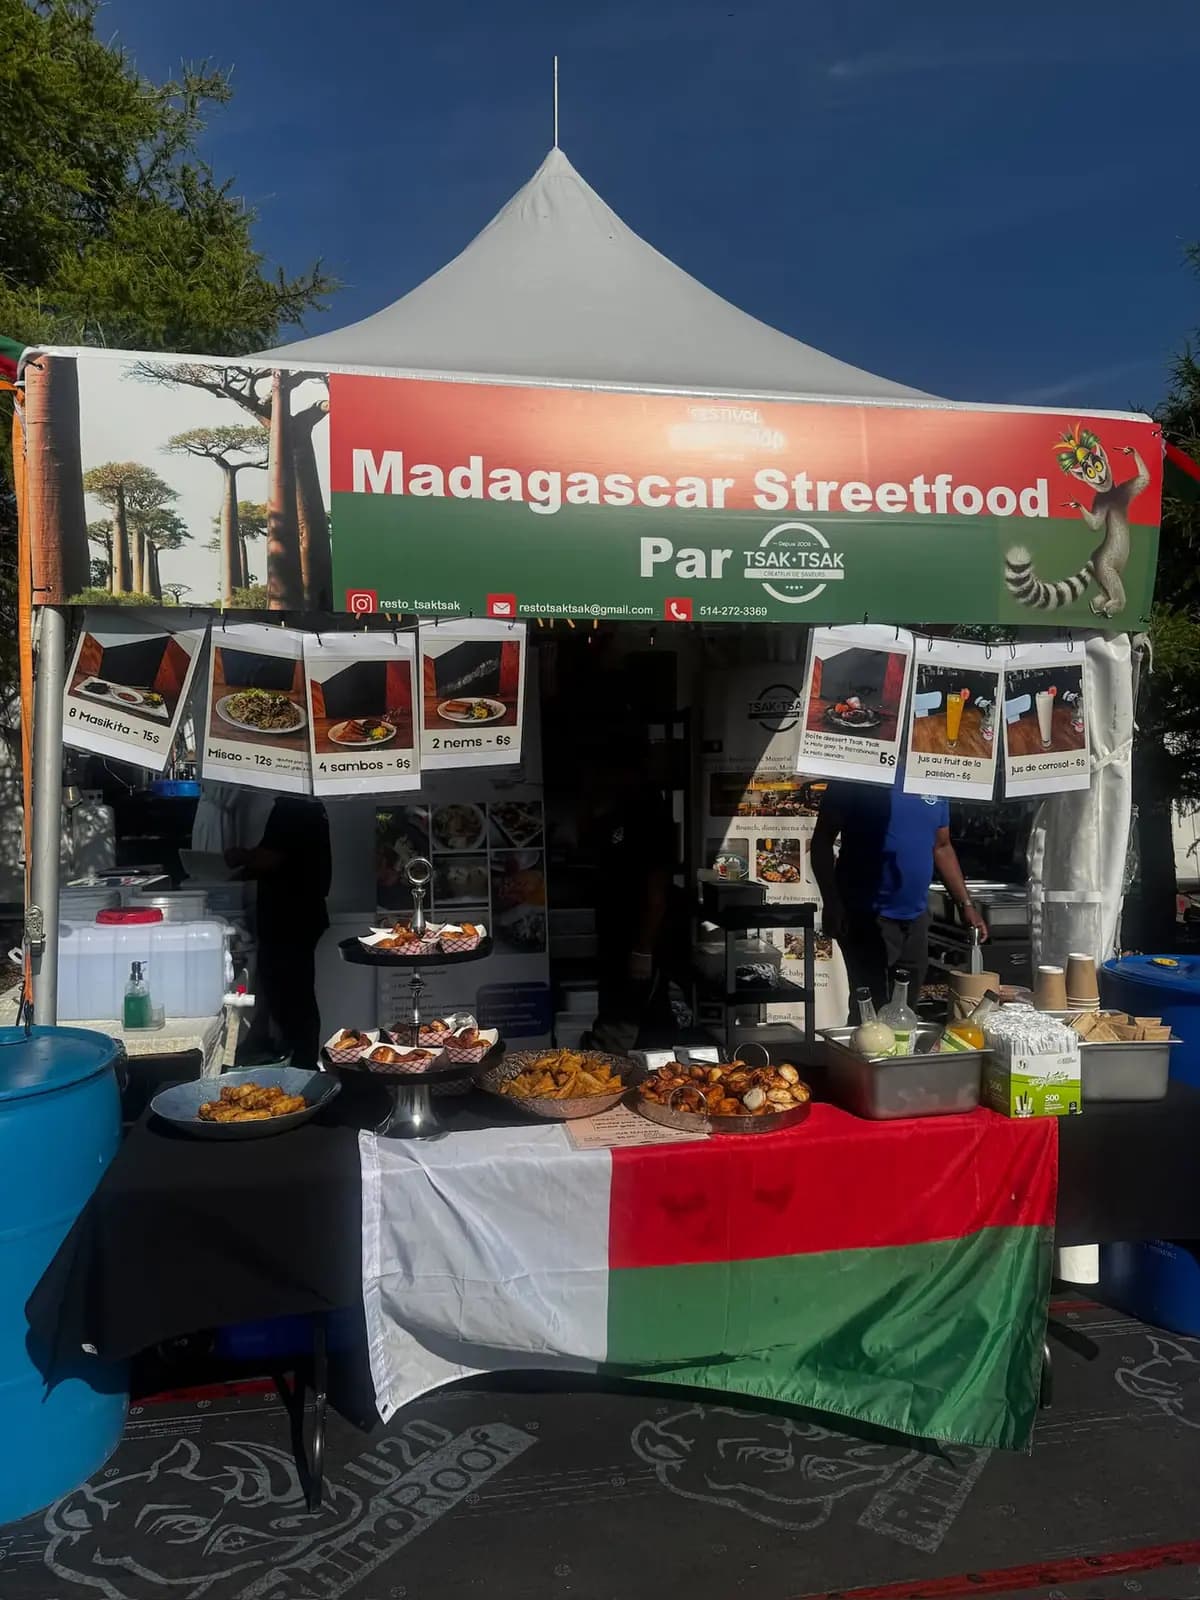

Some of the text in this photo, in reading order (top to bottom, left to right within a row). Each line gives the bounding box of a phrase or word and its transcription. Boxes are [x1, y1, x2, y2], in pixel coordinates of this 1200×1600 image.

[352, 448, 1048, 518] Madagascar Streetfood
[640, 537, 732, 579] Par
[379, 598, 461, 611] resto_tsaktsak
[519, 602, 654, 616] restotsaktsak@gmail.com
[699, 605, 768, 617] 514-272-3369
[748, 701, 802, 712] TSAK·TSA
[68, 707, 77, 718] 8
[78, 711, 131, 735] Masikita
[432, 737, 440, 749] 2
[443, 738, 483, 748] nems
[208, 748, 242, 761] Misao
[319, 761, 327, 772] 4
[330, 760, 384, 772] sambos
[944, 756, 961, 766] fruit
[962, 759, 973, 767] de
[973, 759, 982, 768] la
[1025, 763, 1037, 772] de
[1038, 759, 1069, 771] corrosol
[925, 769, 955, 778] passion
[1044, 1094, 1060, 1102] 500
